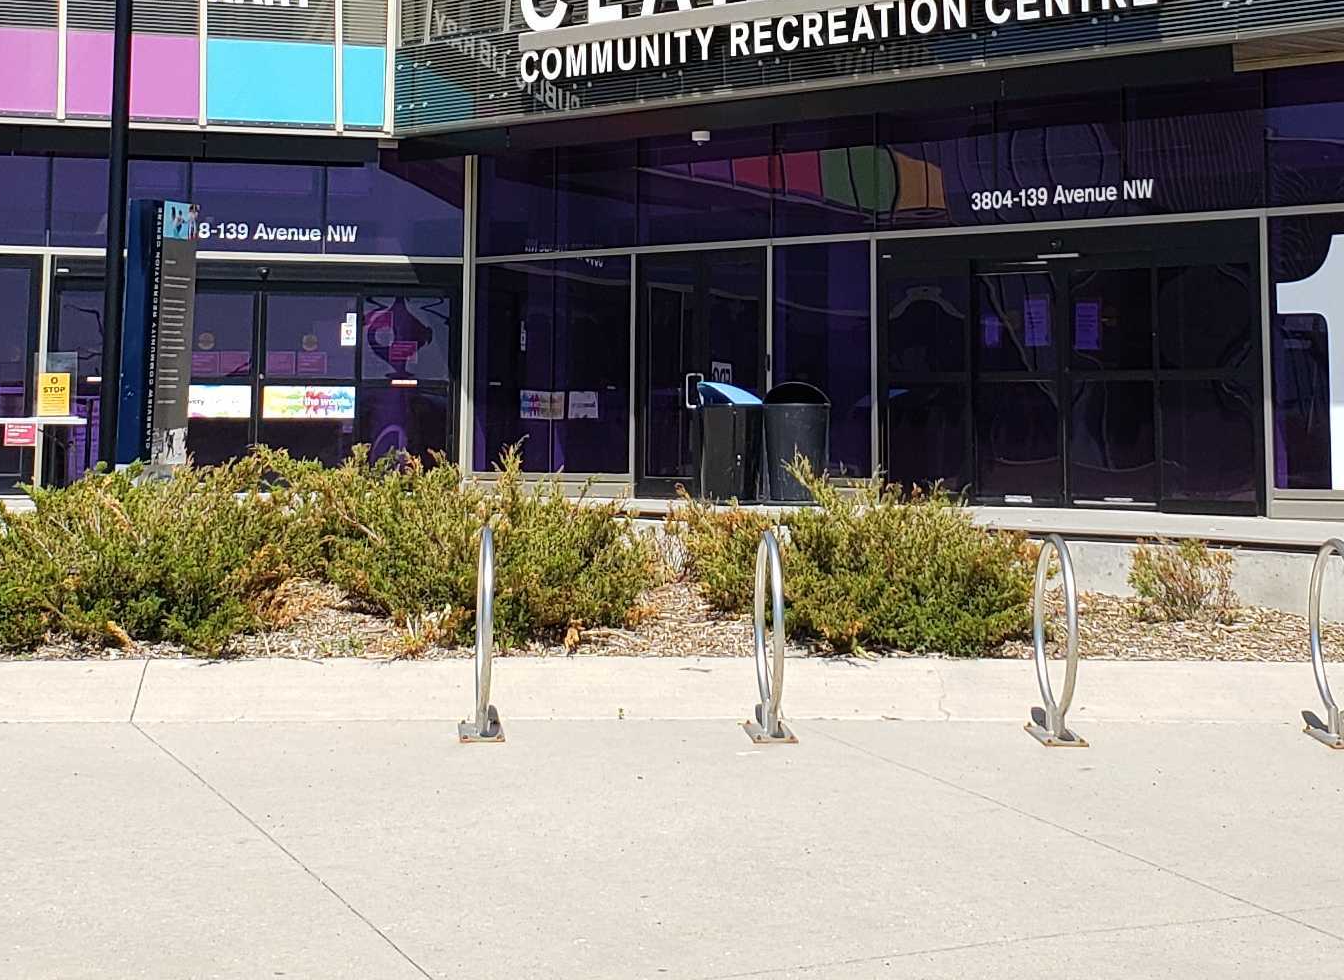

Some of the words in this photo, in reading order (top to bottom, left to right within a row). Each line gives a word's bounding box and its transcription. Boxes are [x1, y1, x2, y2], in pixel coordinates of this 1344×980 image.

[520, 23, 714, 83] COMMUNITY
[971, 187, 1048, 210] 3804-139
[1053, 185, 1119, 205] Avenue
[1123, 178, 1155, 200] NW
[197, 222, 249, 240] 8-139
[253, 223, 321, 242] Avenue
[326, 225, 358, 243] NW
[148, 322, 157, 385] COMMUNITY
[43, 386, 66, 394] STOP
